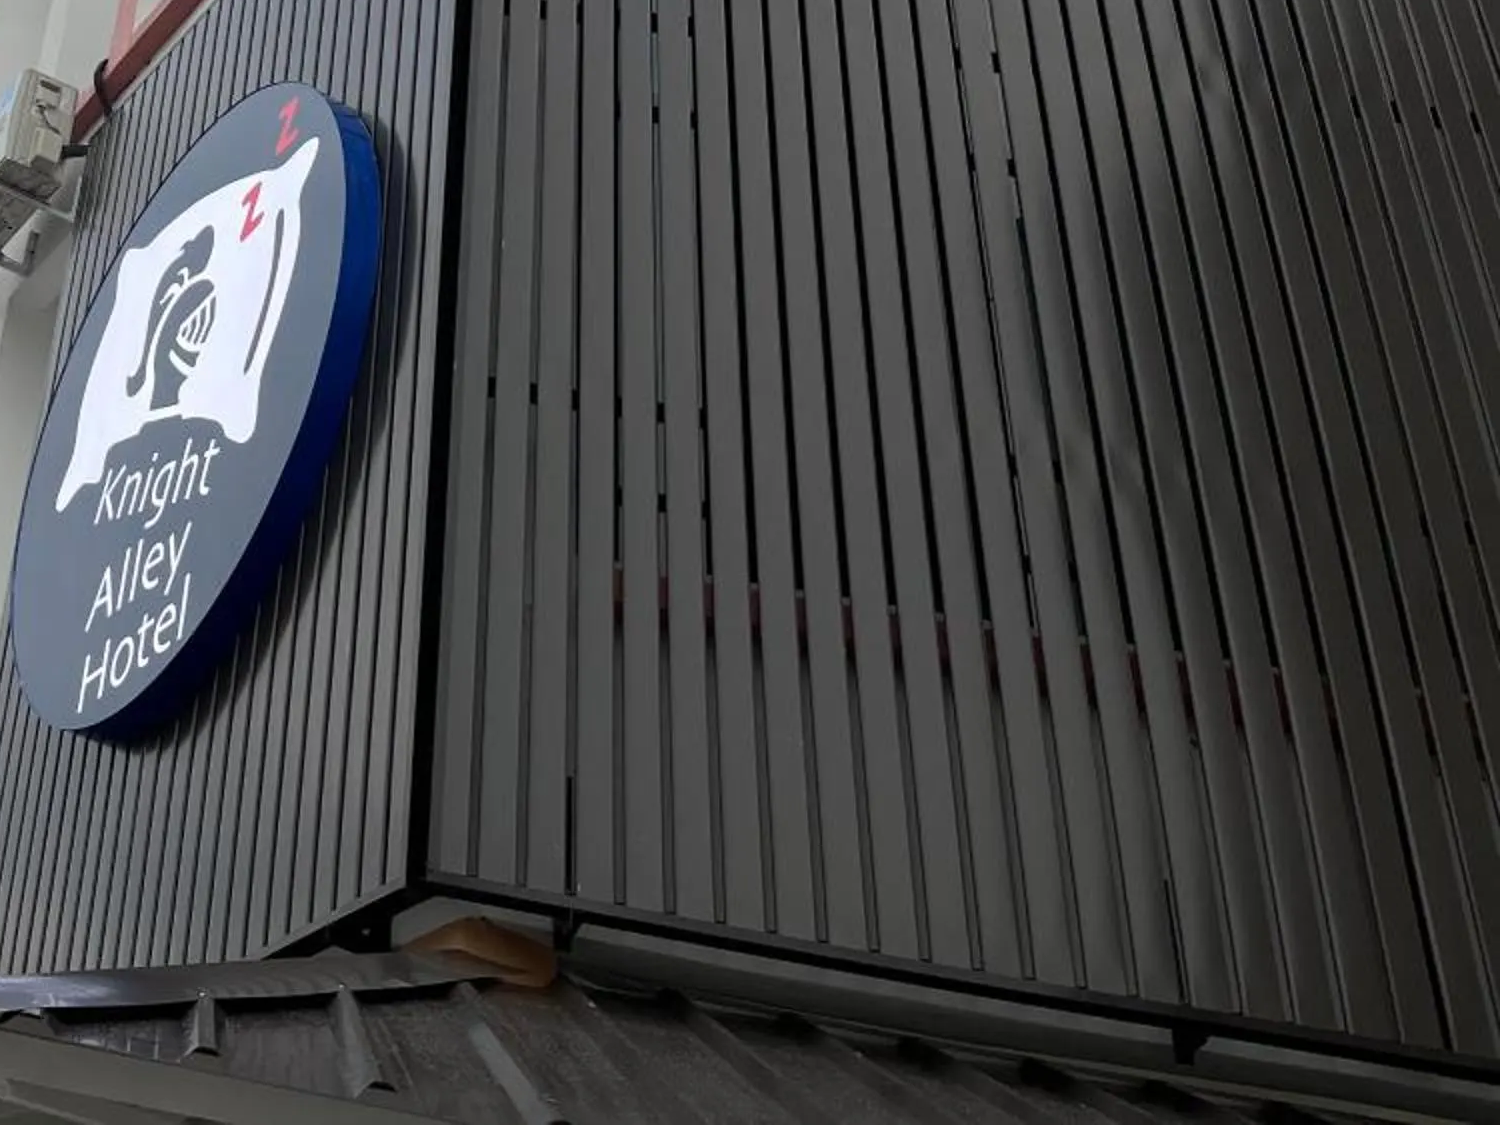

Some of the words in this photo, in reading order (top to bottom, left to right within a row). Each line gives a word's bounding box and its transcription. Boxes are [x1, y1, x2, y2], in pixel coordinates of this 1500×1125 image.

[94, 438, 221, 529] Knight
[84, 521, 192, 633] Alley
[77, 573, 191, 714] Hotel
